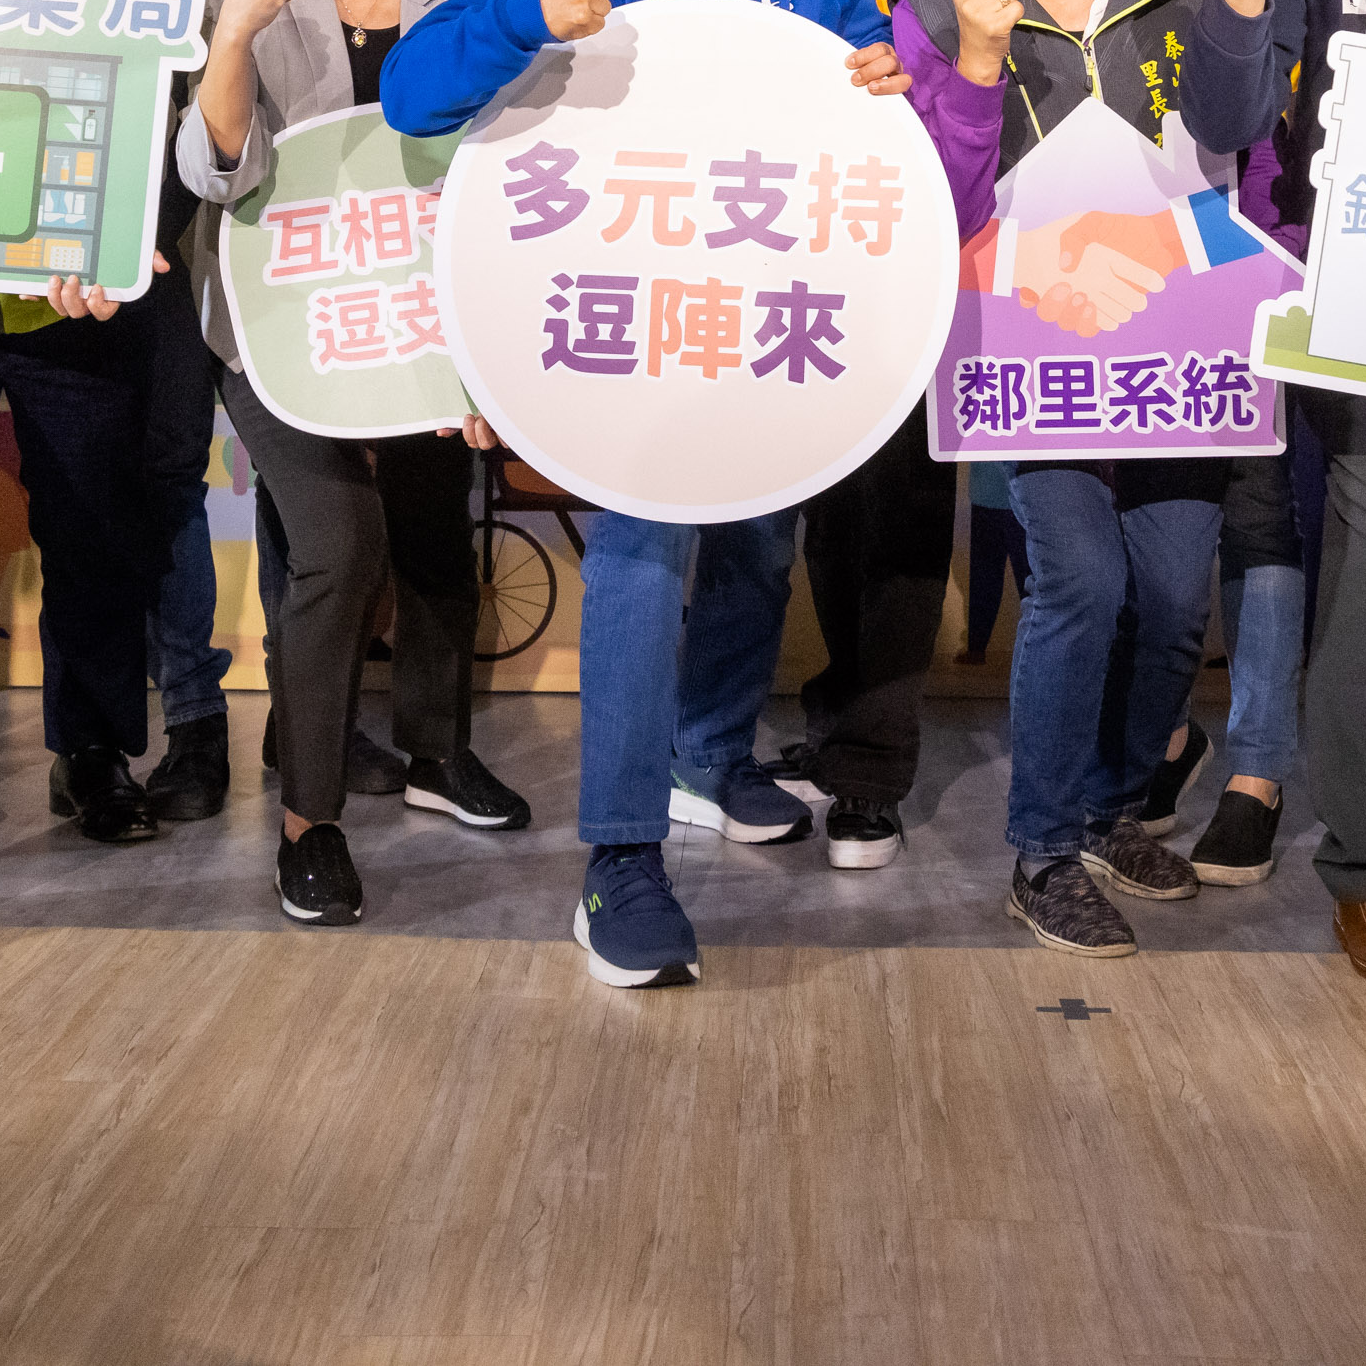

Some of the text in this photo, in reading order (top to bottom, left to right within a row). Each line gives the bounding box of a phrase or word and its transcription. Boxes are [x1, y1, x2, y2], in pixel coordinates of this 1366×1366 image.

[1140, 60, 1172, 119] 里長
[503, 140, 904, 256] 多元支持
[543, 273, 846, 384] 逗陣來
[959, 356, 1259, 431] 鄰里系統
